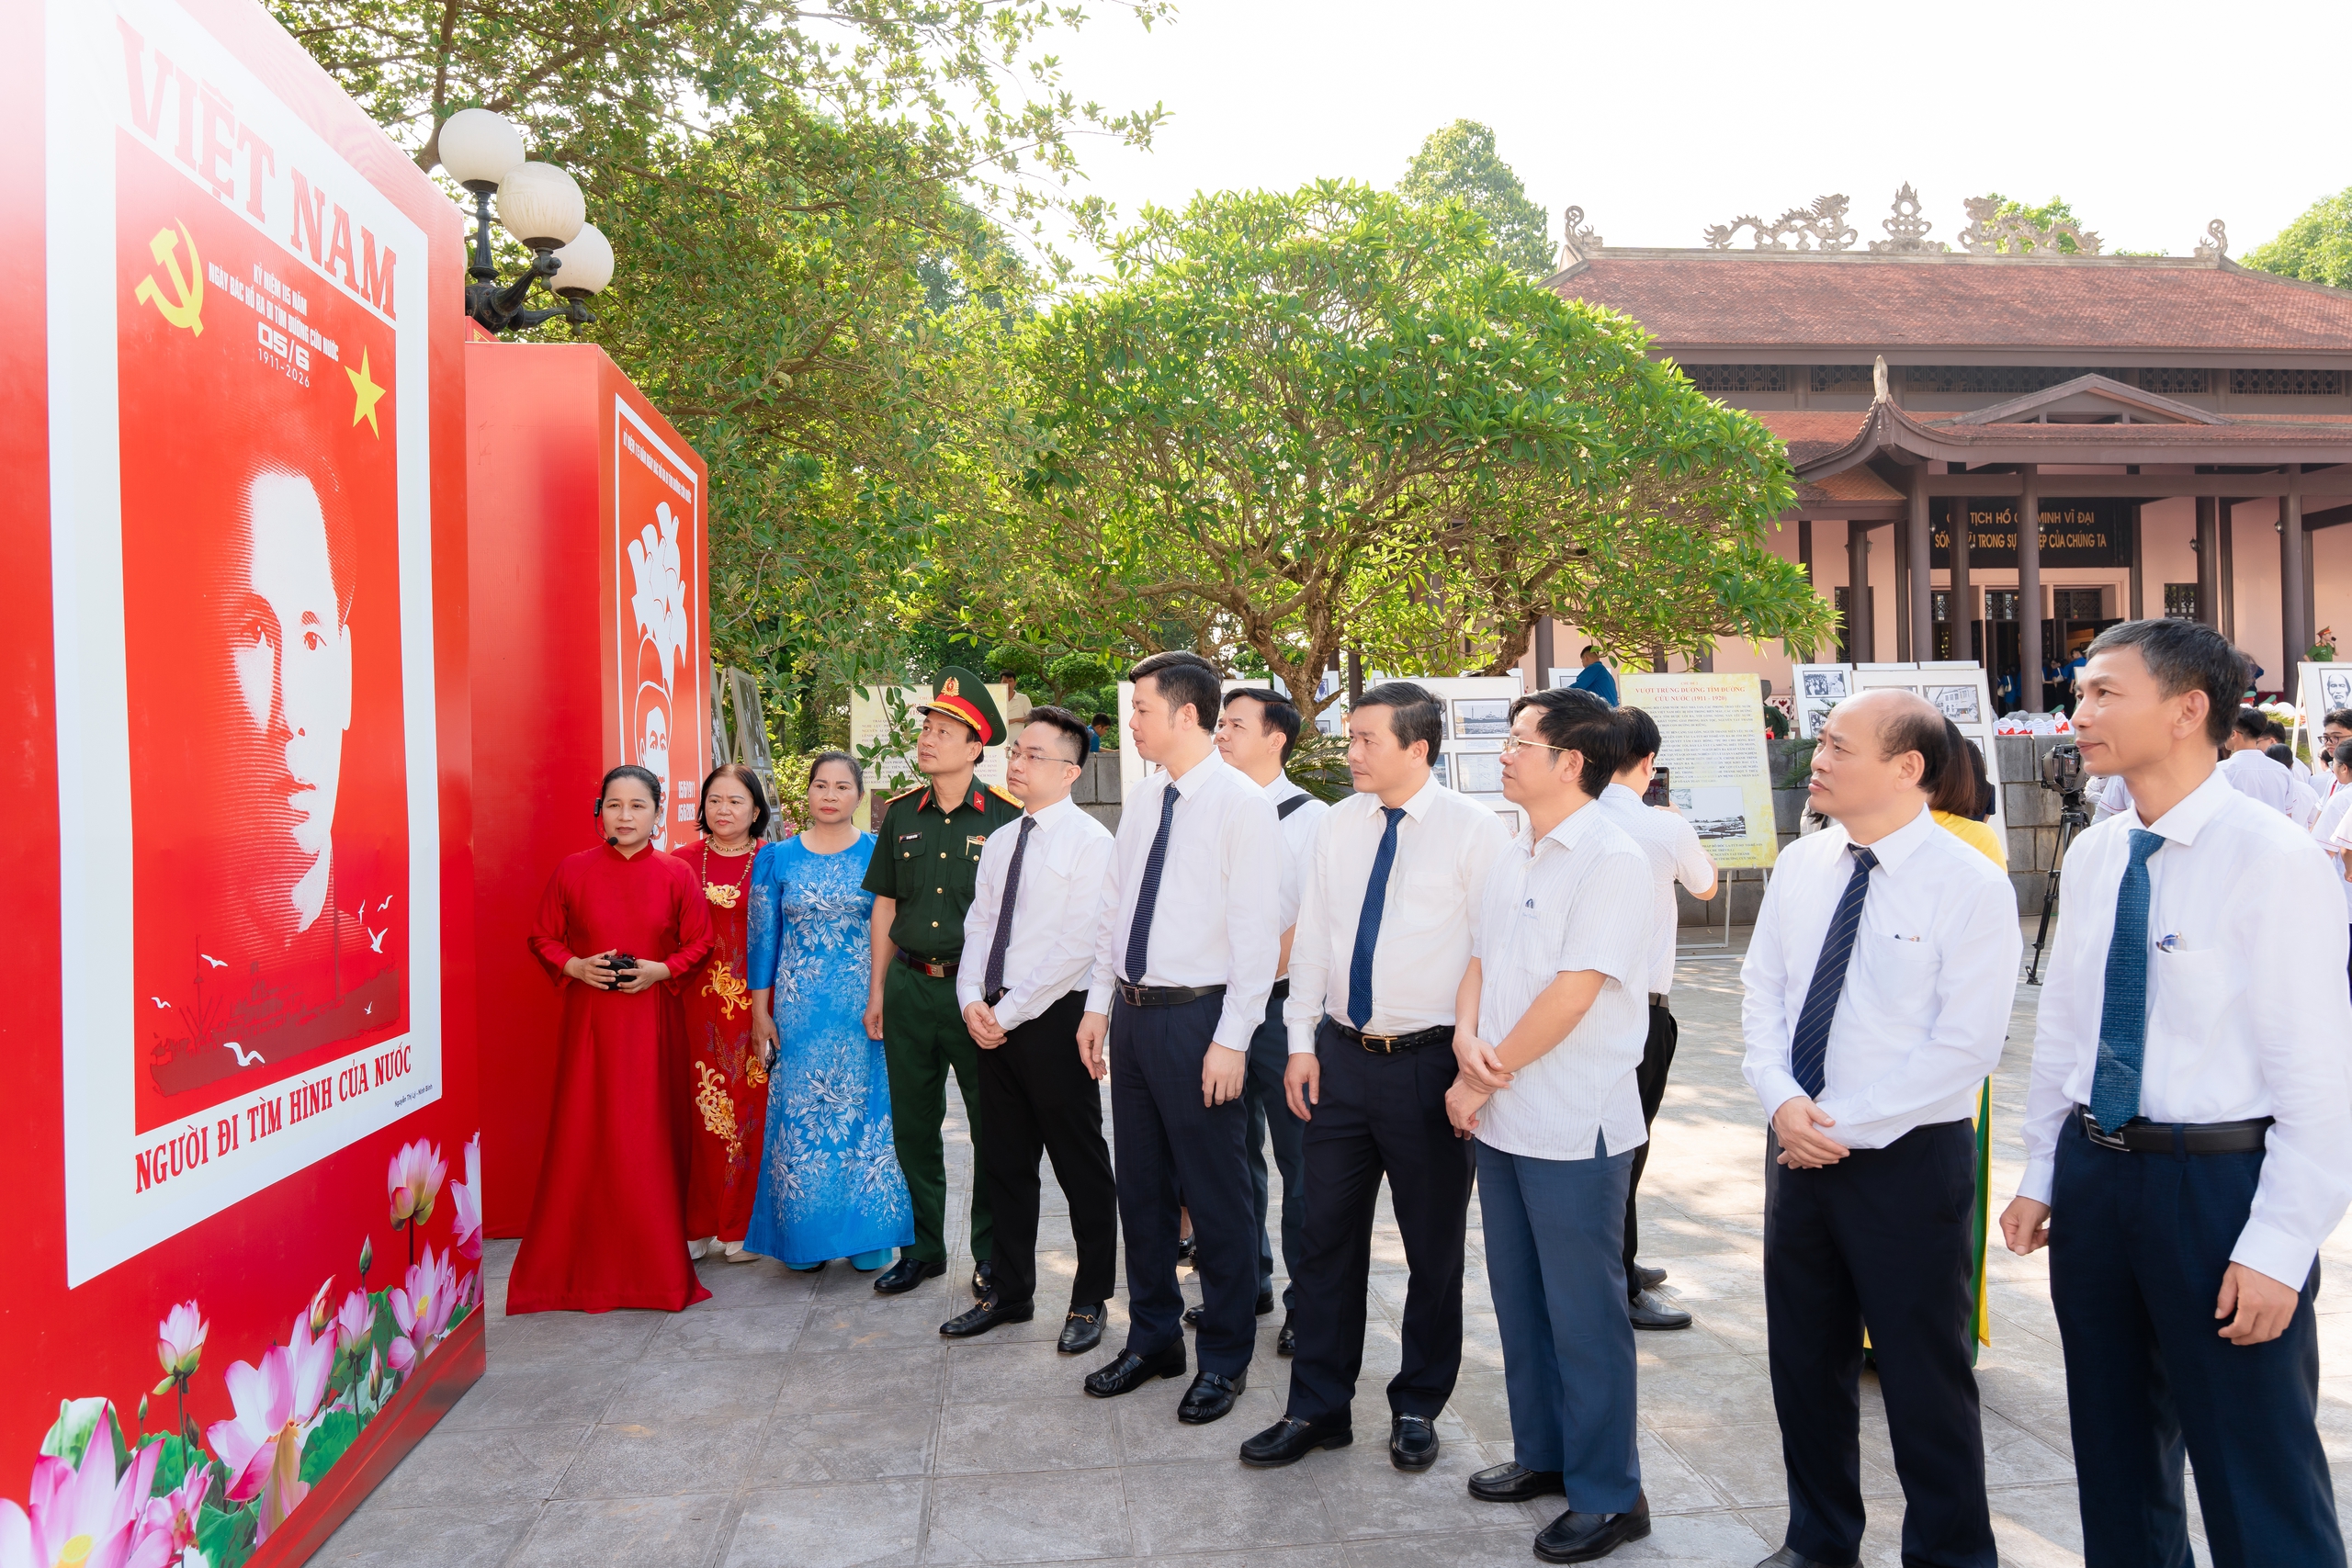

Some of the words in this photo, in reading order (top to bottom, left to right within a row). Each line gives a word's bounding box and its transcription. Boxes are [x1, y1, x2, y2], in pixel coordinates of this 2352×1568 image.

[117, 14, 275, 223] VIỆT
[291, 166, 397, 321] NAM
[209, 261, 228, 291] NGÀY
[230, 275, 243, 302] BÁC
[256, 292, 266, 316] RA
[266, 299, 273, 321] ĐI
[275, 304, 287, 330] TÌM
[288, 313, 309, 344] ĐƯỜNG
[310, 328, 322, 352] CỨU
[322, 336, 339, 362] NƯỚC
[292, 290, 308, 317] NĂM
[257, 321, 310, 372] 05/6
[258, 348, 310, 388] 1911-2026
[1935, 530, 1951, 548] SỐN
[1977, 534, 2006, 548] TRONG
[2049, 529, 2066, 548] CỦA
[2066, 530, 2096, 548] CHÚNG
[2097, 534, 2107, 547] TA
[1969, 512, 1993, 526] TỊCH
[2037, 512, 2061, 524] MINH
[2064, 508, 2075, 524] VĨ
[2077, 512, 2095, 525] ĐẠI
[135, 1124, 209, 1195] NGƯỜI
[217, 1110, 239, 1157] ĐI
[246, 1096, 282, 1144] TÌM
[289, 1079, 334, 1126] HÌNH
[338, 1058, 369, 1102] CỦA
[374, 1041, 413, 1088] NƯỚC
